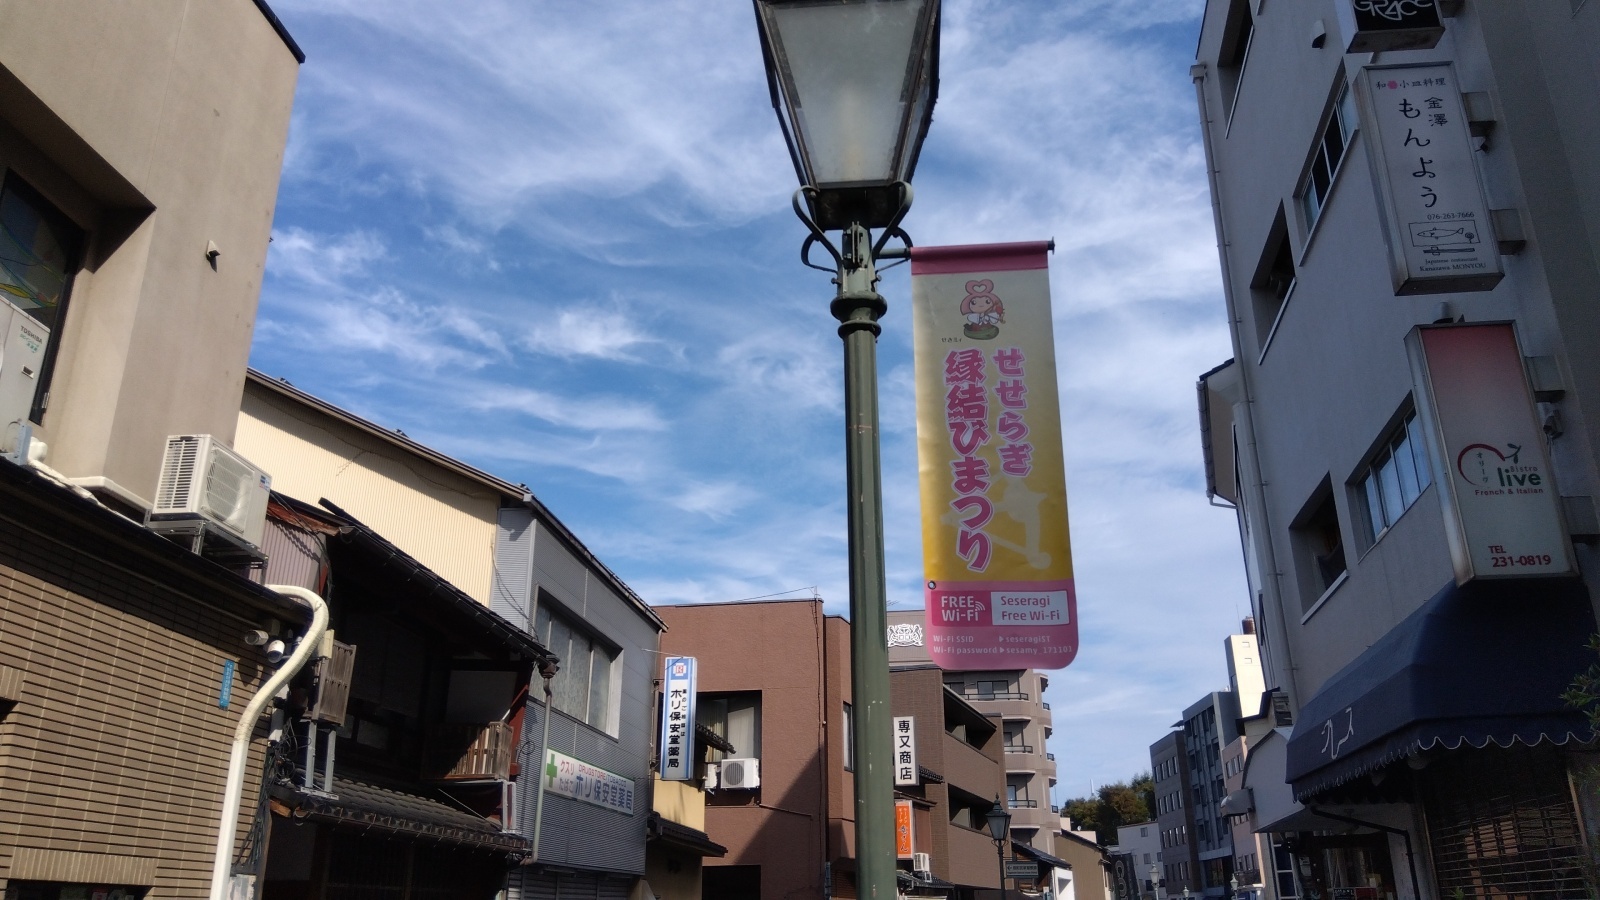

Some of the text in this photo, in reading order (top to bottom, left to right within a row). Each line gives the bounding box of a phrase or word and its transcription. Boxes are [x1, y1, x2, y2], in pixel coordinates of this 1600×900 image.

[1424, 96, 1449, 127] 金澤
[1398, 98, 1438, 208] もんよう
[1452, 262, 1487, 270] MONYOU
[20, 325, 42, 344] TOSHIBA
[993, 346, 1033, 478] せせらぎ
[943, 348, 994, 573] 縁結びまつり
[1510, 465, 1538, 473] Bistro
[1488, 545, 1506, 554] TEL
[1491, 554, 1551, 567] 231-0819
[941, 595, 975, 608] FREE
[1000, 595, 1050, 608] Seseragi
[941, 609, 979, 622] Wi-Fi
[1001, 609, 1060, 621] Free Wi-Fi
[932, 635, 974, 643] Wi-Fi SSID
[1005, 635, 1051, 645] seseragiST
[933, 646, 998, 656] Wi-Fi password
[667, 688, 683, 768] ホリ保安堂薬局
[898, 719, 912, 780] 専又商店
[560, 759, 575, 776] クスリ
[558, 777, 574, 793] たばこ
[575, 774, 633, 810] ホリ保安堂薬局
